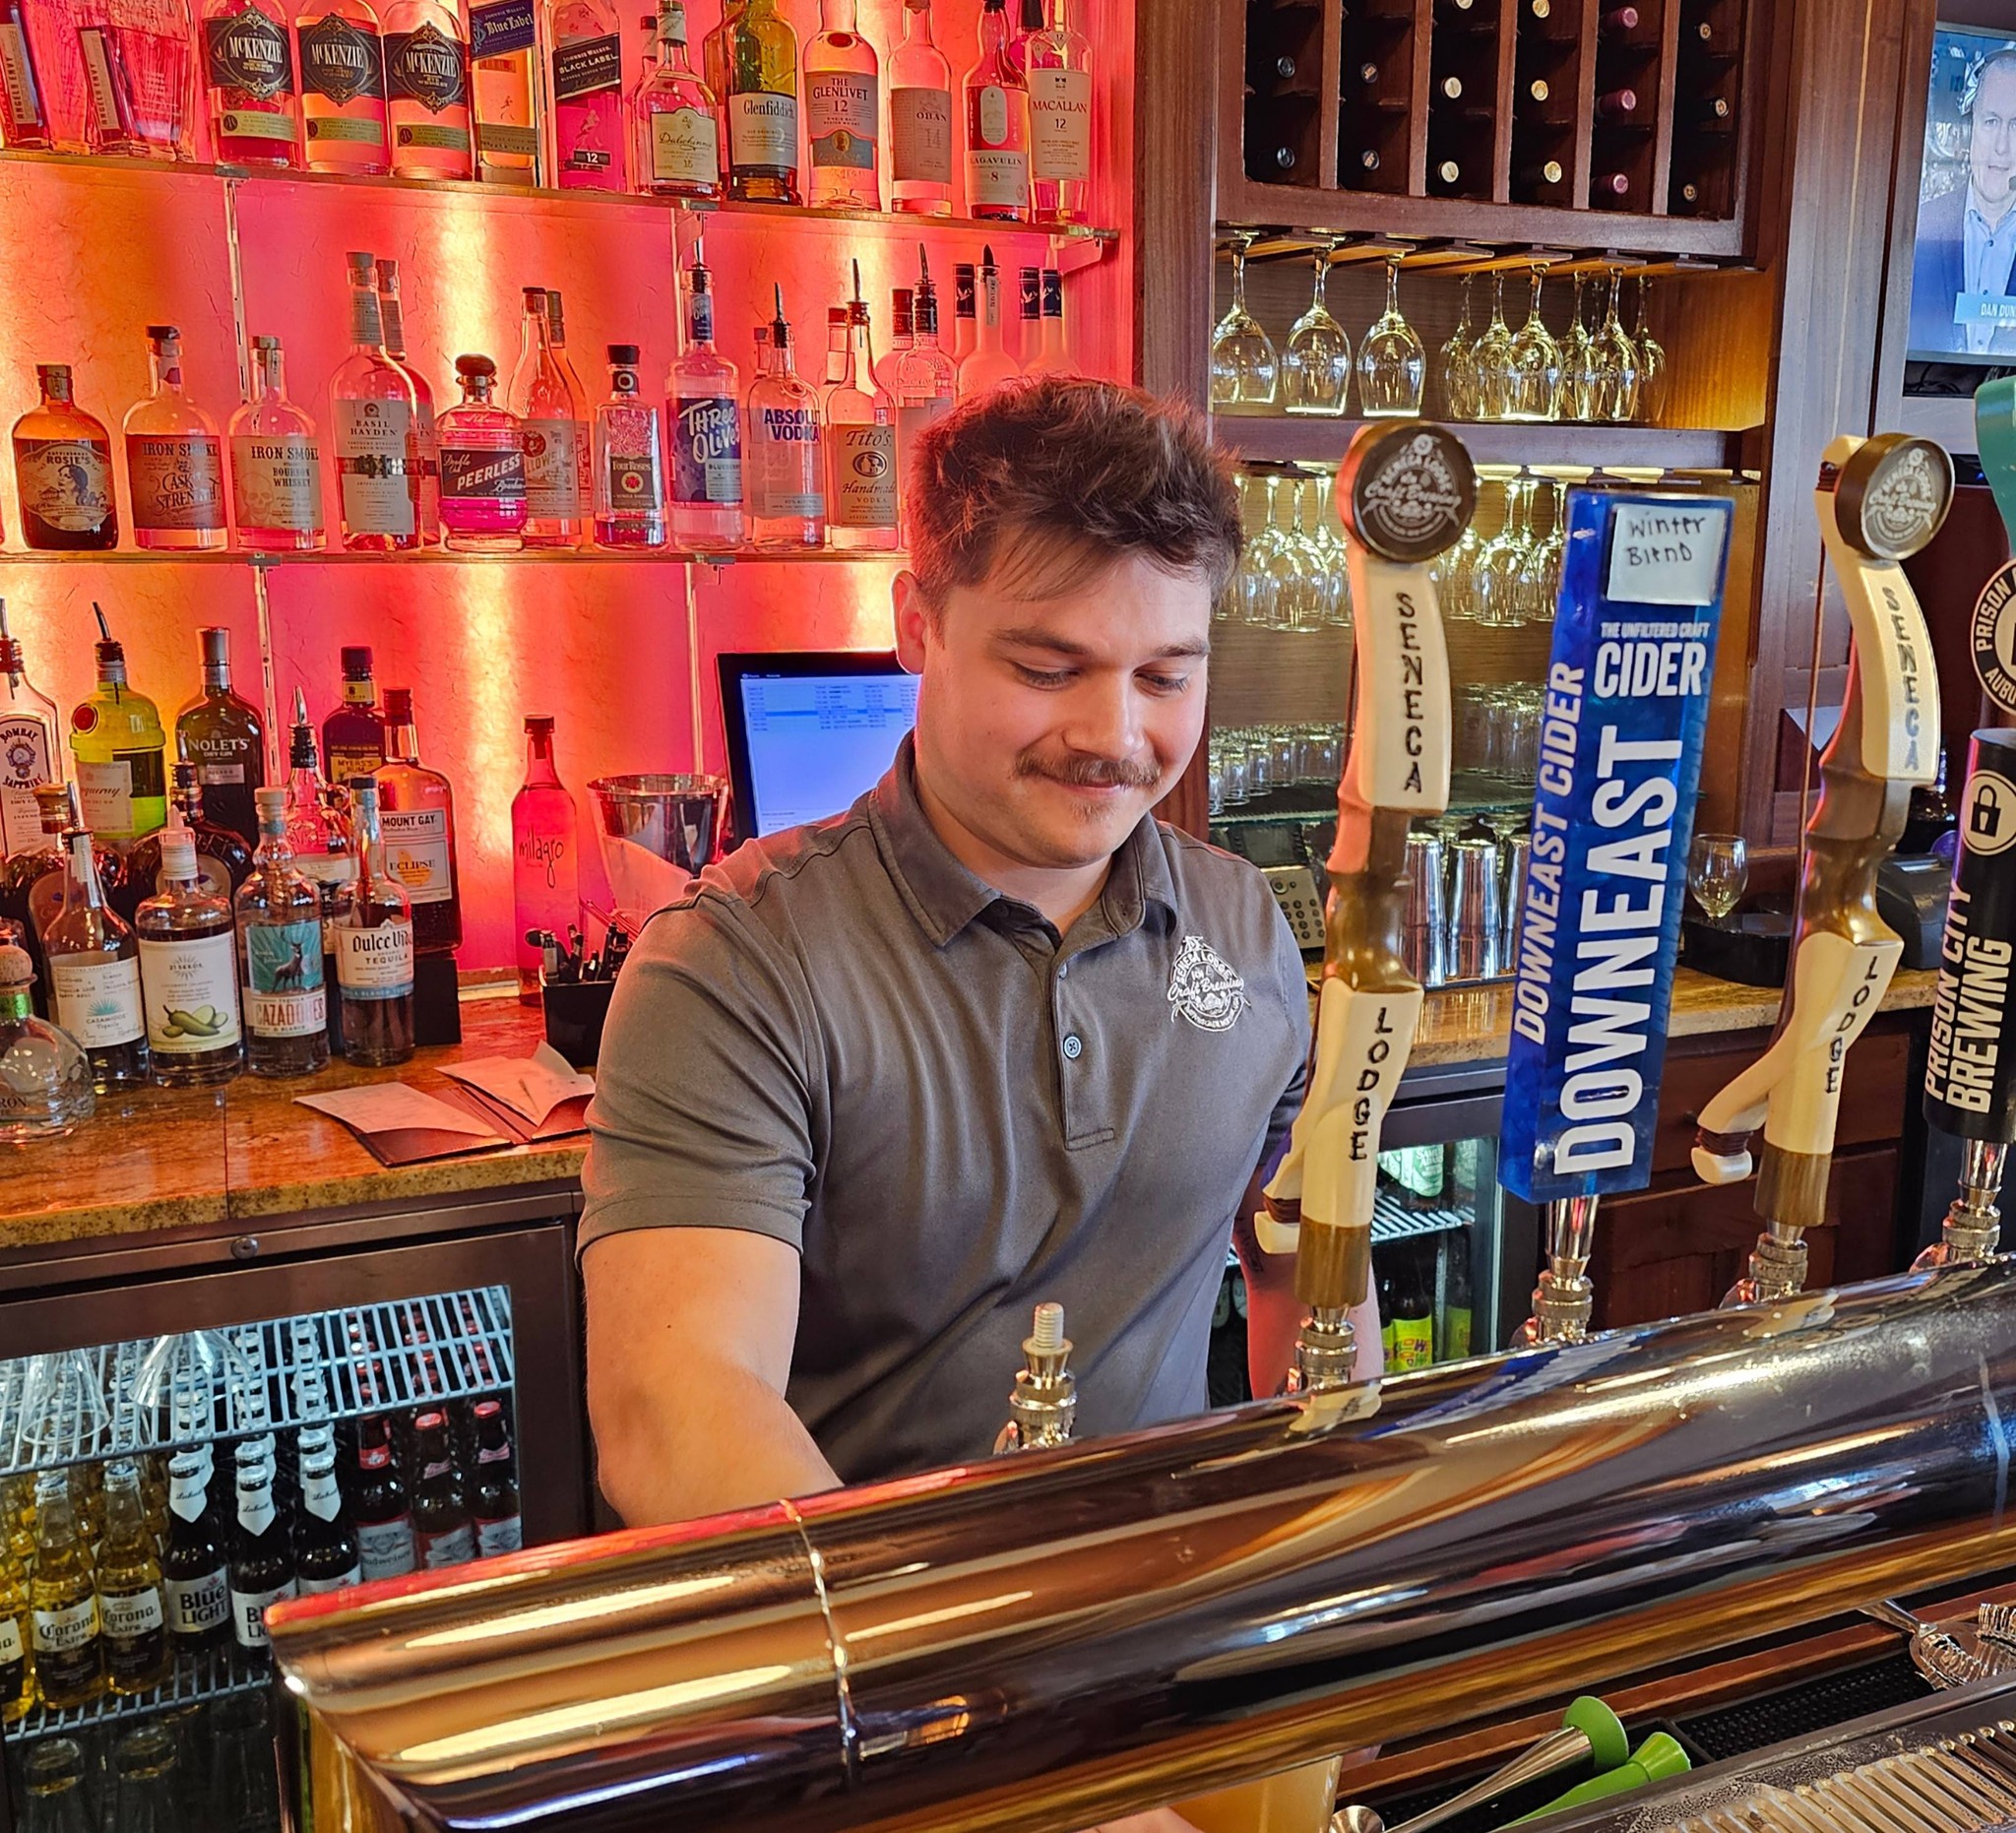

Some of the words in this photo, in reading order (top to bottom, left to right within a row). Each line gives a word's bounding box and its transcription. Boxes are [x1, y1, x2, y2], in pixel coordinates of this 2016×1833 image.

[483, 20, 508, 36] Blue
[507, 14, 534, 30] Label
[558, 60, 587, 75] BLACK
[589, 53, 619, 65] LABEL
[831, 78, 849, 87] THE
[813, 87, 868, 101] GLENLIVET
[743, 99, 795, 119] Glenfiddich
[834, 100, 849, 112] 12
[1034, 100, 1088, 113] MACALLAN
[915, 112, 947, 122] OBAN
[1055, 118, 1066, 129] 12
[587, 153, 598, 163] 12
[971, 157, 1023, 165] LAGAVULIN
[990, 171, 999, 182] 8
[1981, 303, 1998, 316] DAN
[1998, 304, 2016, 317] DUN
[355, 419, 391, 428] BASIL
[764, 409, 820, 425] ABSOLUT
[350, 427, 397, 436] HAYDEN
[772, 425, 820, 442] VODKA
[847, 429, 891, 447] Tito's
[142, 442, 174, 456] IRON
[179, 443, 218, 456] SKE
[251, 446, 283, 460] IRON
[457, 452, 521, 491] PEERLESS
[1976, 577, 2012, 652] PRISON
[1601, 622, 1621, 638] THE
[1593, 641, 1707, 698] CIDER
[1881, 586, 1920, 771] SENECA
[1984, 667, 2016, 705] AUBU
[1396, 593, 1423, 793] SENECA
[0, 727, 38, 744] BOMBAY
[1539, 662, 1585, 798] CIDER
[189, 737, 248, 750] NOLET'S
[382, 816, 415, 827] MOUNT
[418, 815, 435, 825] GAY
[519, 823, 564, 888] milagro
[389, 859, 435, 871] ECLIPSE
[1513, 802, 1568, 1046] DOWNEAST
[1941, 880, 1971, 968] CITY
[353, 933, 391, 953] Dulce
[1553, 725, 1682, 1175] DOWNEAST
[366, 954, 408, 965] TEQUILA
[1167, 981, 1200, 1001] Craft
[1200, 978, 1244, 992] Brewing
[255, 996, 324, 1026] CAZADOES
[1825, 955, 1878, 1095] LODGE
[1946, 937, 2013, 1114] BREWING
[1924, 972, 1959, 1102] PRISON
[1349, 1006, 1393, 1162] LODGE
[180, 1585, 225, 1610] Blue
[101, 1607, 154, 1624] Corona
[182, 1600, 226, 1624] LIGHT
[247, 1606, 266, 1623] Bl
[39, 1613, 95, 1640] Corona
[56, 1633, 87, 1647] Extra
